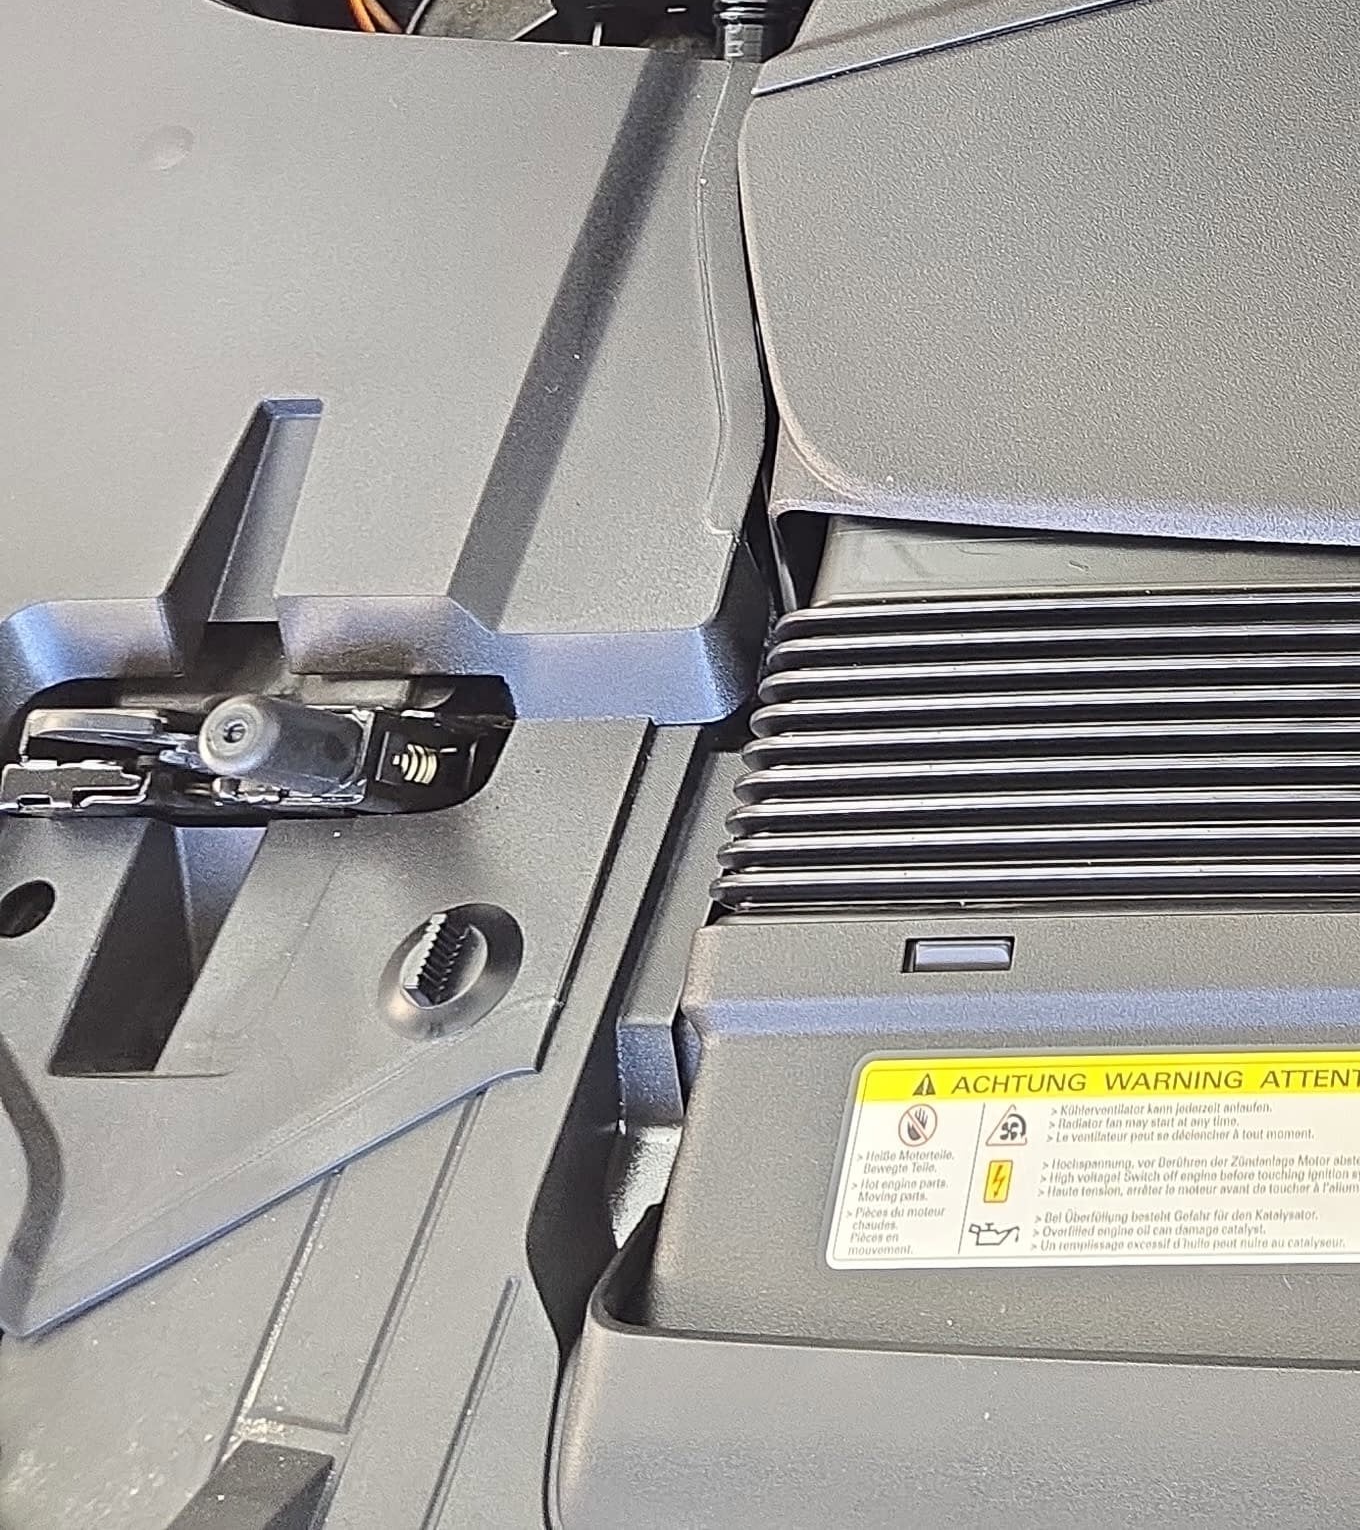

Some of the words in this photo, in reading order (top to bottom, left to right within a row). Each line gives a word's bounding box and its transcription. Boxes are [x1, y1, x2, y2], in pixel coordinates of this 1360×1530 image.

[951, 1075, 1087, 1092] ACHTUNG
[1106, 1070, 1243, 1091] WARNING
[1147, 1103, 1172, 1114] kann
[1058, 1119, 1103, 1129] Radiator
[1105, 1118, 1123, 1129] fan
[1125, 1120, 1148, 1130] may
[1150, 1117, 1175, 1127] start
[1177, 1118, 1188, 1127] at
[1191, 1119, 1209, 1129] any
[1213, 1116, 1239, 1127] time.
[1057, 1133, 1068, 1142] Le
[1071, 1132, 1128, 1142] ventilateur
[1131, 1131, 1154, 1144] peut
[1157, 1133, 1170, 1141] se
[1242, 1129, 1264, 1139] tout
[1266, 1129, 1314, 1139] moment.
[900, 1150, 954, 1161] Motorteile.
[1052, 1159, 1135, 1171] Hochspannung,
[1138, 1159, 1156, 1168] vor
[1210, 1157, 1228, 1167] der
[1298, 1155, 1330, 1166] Motor
[1050, 1171, 1074, 1185] High
[1124, 1170, 1160, 1182] Switch
[1163, 1170, 1177, 1181] off
[1181, 1171, 1217, 1183] engine
[1220, 1169, 1255, 1181] before
[1258, 1170, 1305, 1182] touching
[1308, 1168, 1349, 1180] ignition
[861, 1179, 879, 1189] Hot
[882, 1180, 917, 1190] engine
[919, 1178, 949, 1189] parts.
[1048, 1186, 1079, 1197] Haute
[1081, 1186, 1123, 1197] tension,
[1166, 1185, 1175, 1195] le
[1178, 1184, 1217, 1195] moteur
[1220, 1184, 1249, 1193] avant
[1253, 1183, 1266, 1194] de
[1269, 1183, 1310, 1193] toucher
[858, 1192, 897, 1203] Moving
[900, 1192, 928, 1202] parts.
[856, 1207, 888, 1218] Pièces
[891, 1207, 904, 1217] du
[908, 1207, 946, 1217] moteur
[1131, 1211, 1170, 1222] besteht
[1175, 1209, 1211, 1221] Gefahr
[1214, 1209, 1230, 1221] für
[1232, 1209, 1252, 1220] den
[1255, 1209, 1319, 1222] Katalysator.
[852, 1221, 898, 1231] chaudes.
[1097, 1226, 1134, 1238] engine
[1136, 1224, 1150, 1236] oil
[1152, 1227, 1172, 1235] can
[1175, 1224, 1219, 1237] damage
[1222, 1225, 1266, 1236] catalyst.
[850, 1232, 883, 1243] Pièces
[886, 1234, 899, 1242] en
[1041, 1239, 1056, 1251] Un
[1127, 1238, 1170, 1250] excessif
[1213, 1238, 1238, 1250] peut
[1271, 1240, 1285, 1248] au
[1287, 1237, 1346, 1250] catalyseur.
[848, 1245, 913, 1255] mouvement.
